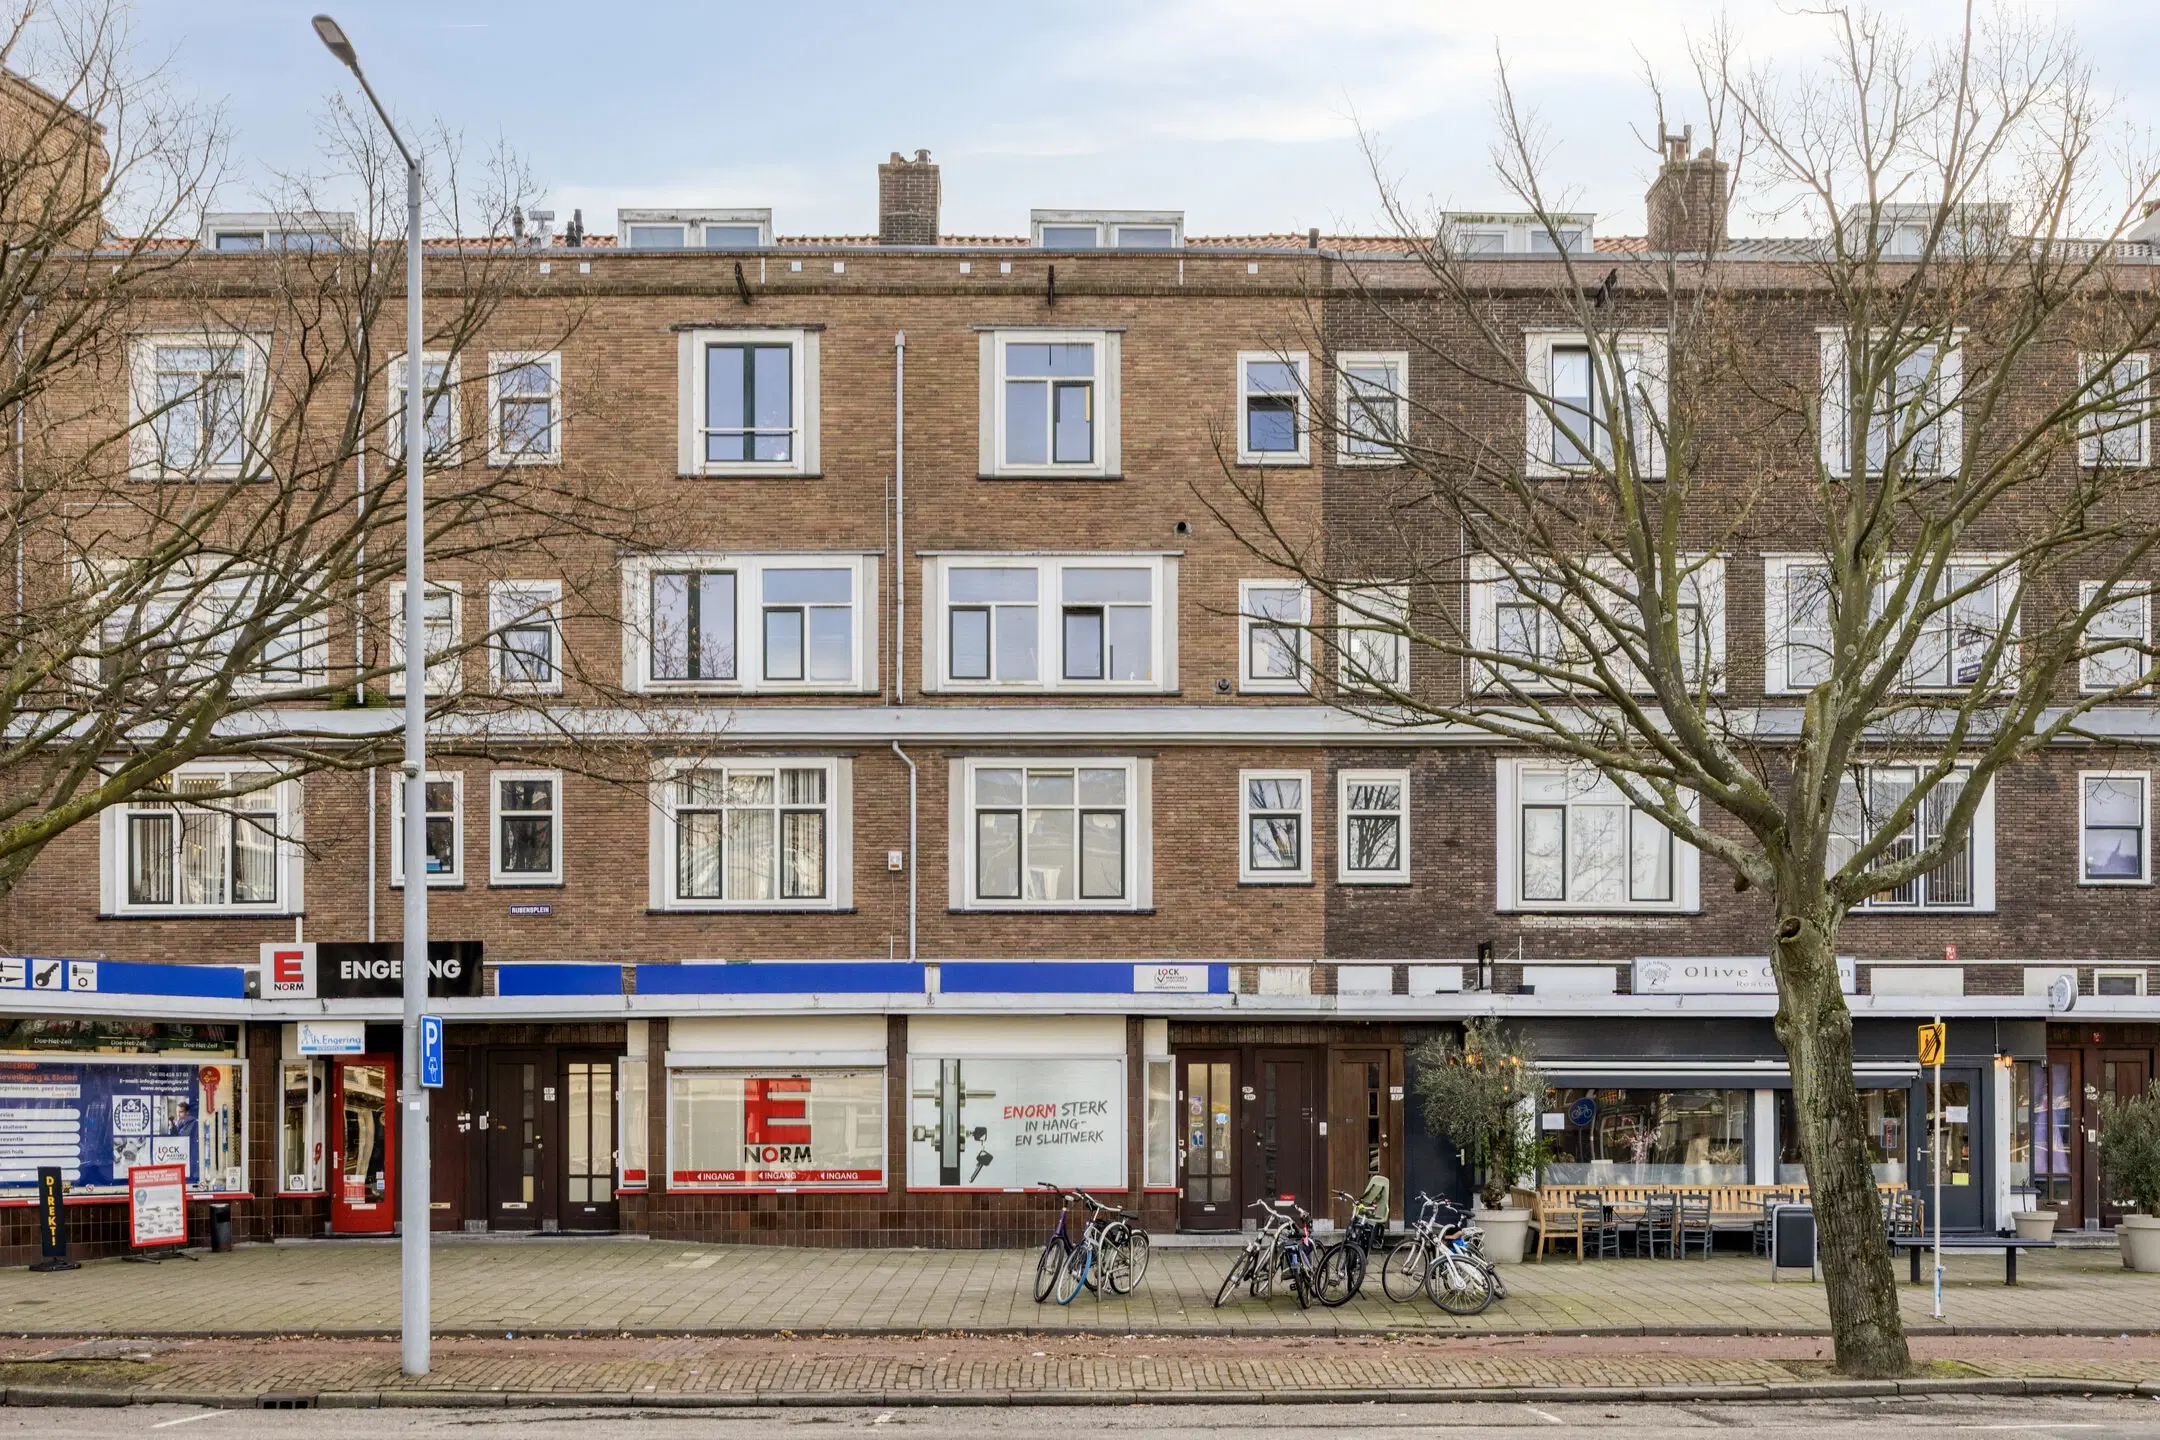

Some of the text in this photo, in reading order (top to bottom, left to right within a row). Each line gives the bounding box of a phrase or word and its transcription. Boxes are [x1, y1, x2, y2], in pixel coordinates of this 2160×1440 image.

[274, 951, 304, 982] E
[340, 959, 461, 979] ENGENG
[1684, 966, 1749, 978] Olive
[273, 983, 304, 991] NORM
[322, 1034, 361, 1045] Engering
[426, 1021, 438, 1057] P
[744, 1078, 811, 1144] E
[1003, 1100, 1108, 1119] ENORM STERK
[1025, 1118, 1087, 1132] IN HANG-
[1015, 1130, 1104, 1147] EN SLUITWERK
[744, 1146, 812, 1163] NORM
[703, 1172, 735, 1181] INGANG
[764, 1171, 797, 1180] INGANG
[826, 1171, 858, 1180] INGANG
